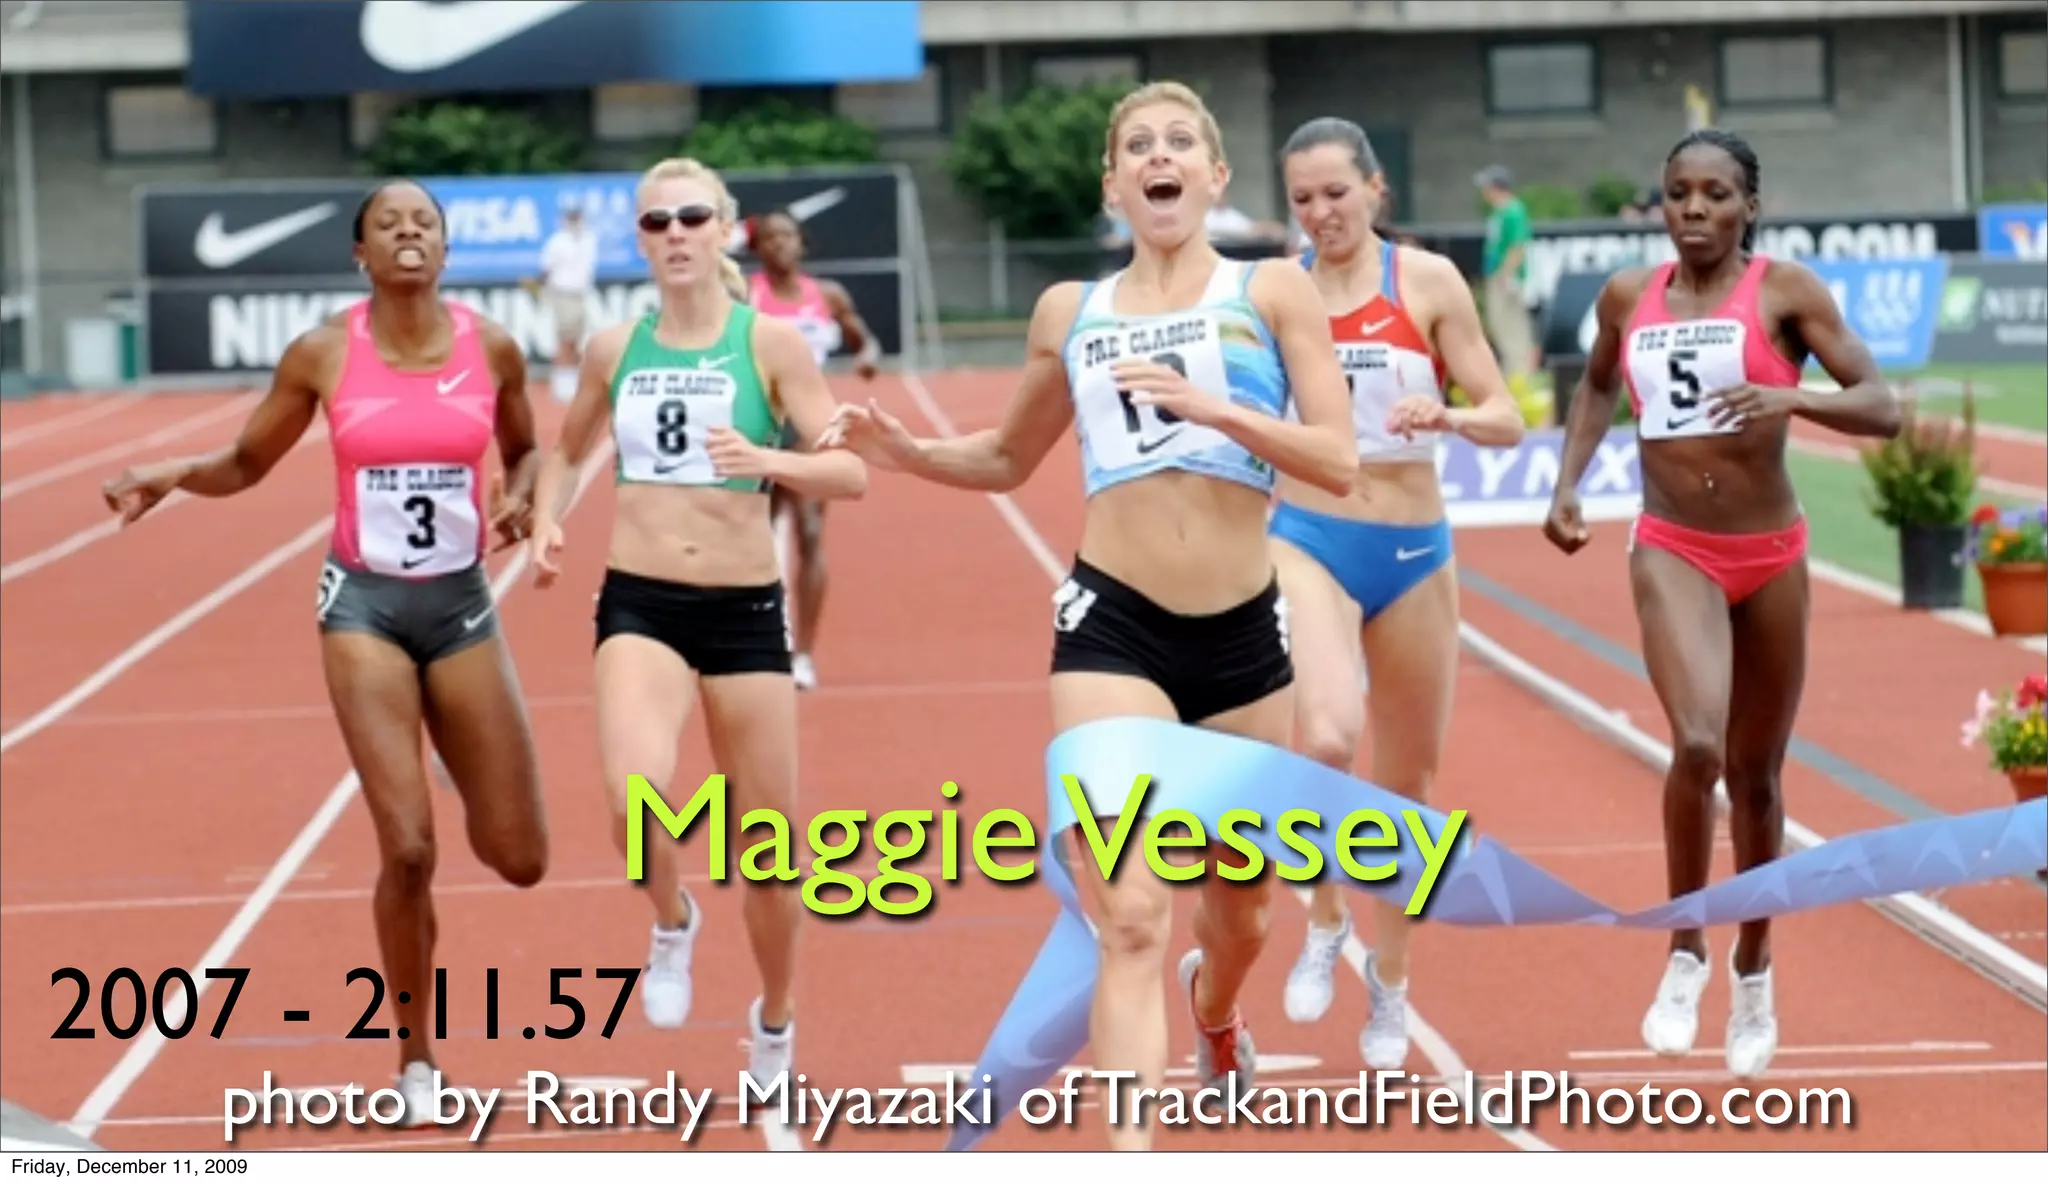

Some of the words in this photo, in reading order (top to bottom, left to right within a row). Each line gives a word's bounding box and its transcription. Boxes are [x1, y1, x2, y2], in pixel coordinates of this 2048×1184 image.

[1668, 351, 1701, 410] 5
[656, 400, 688, 456] 8
[403, 496, 436, 550] 3
